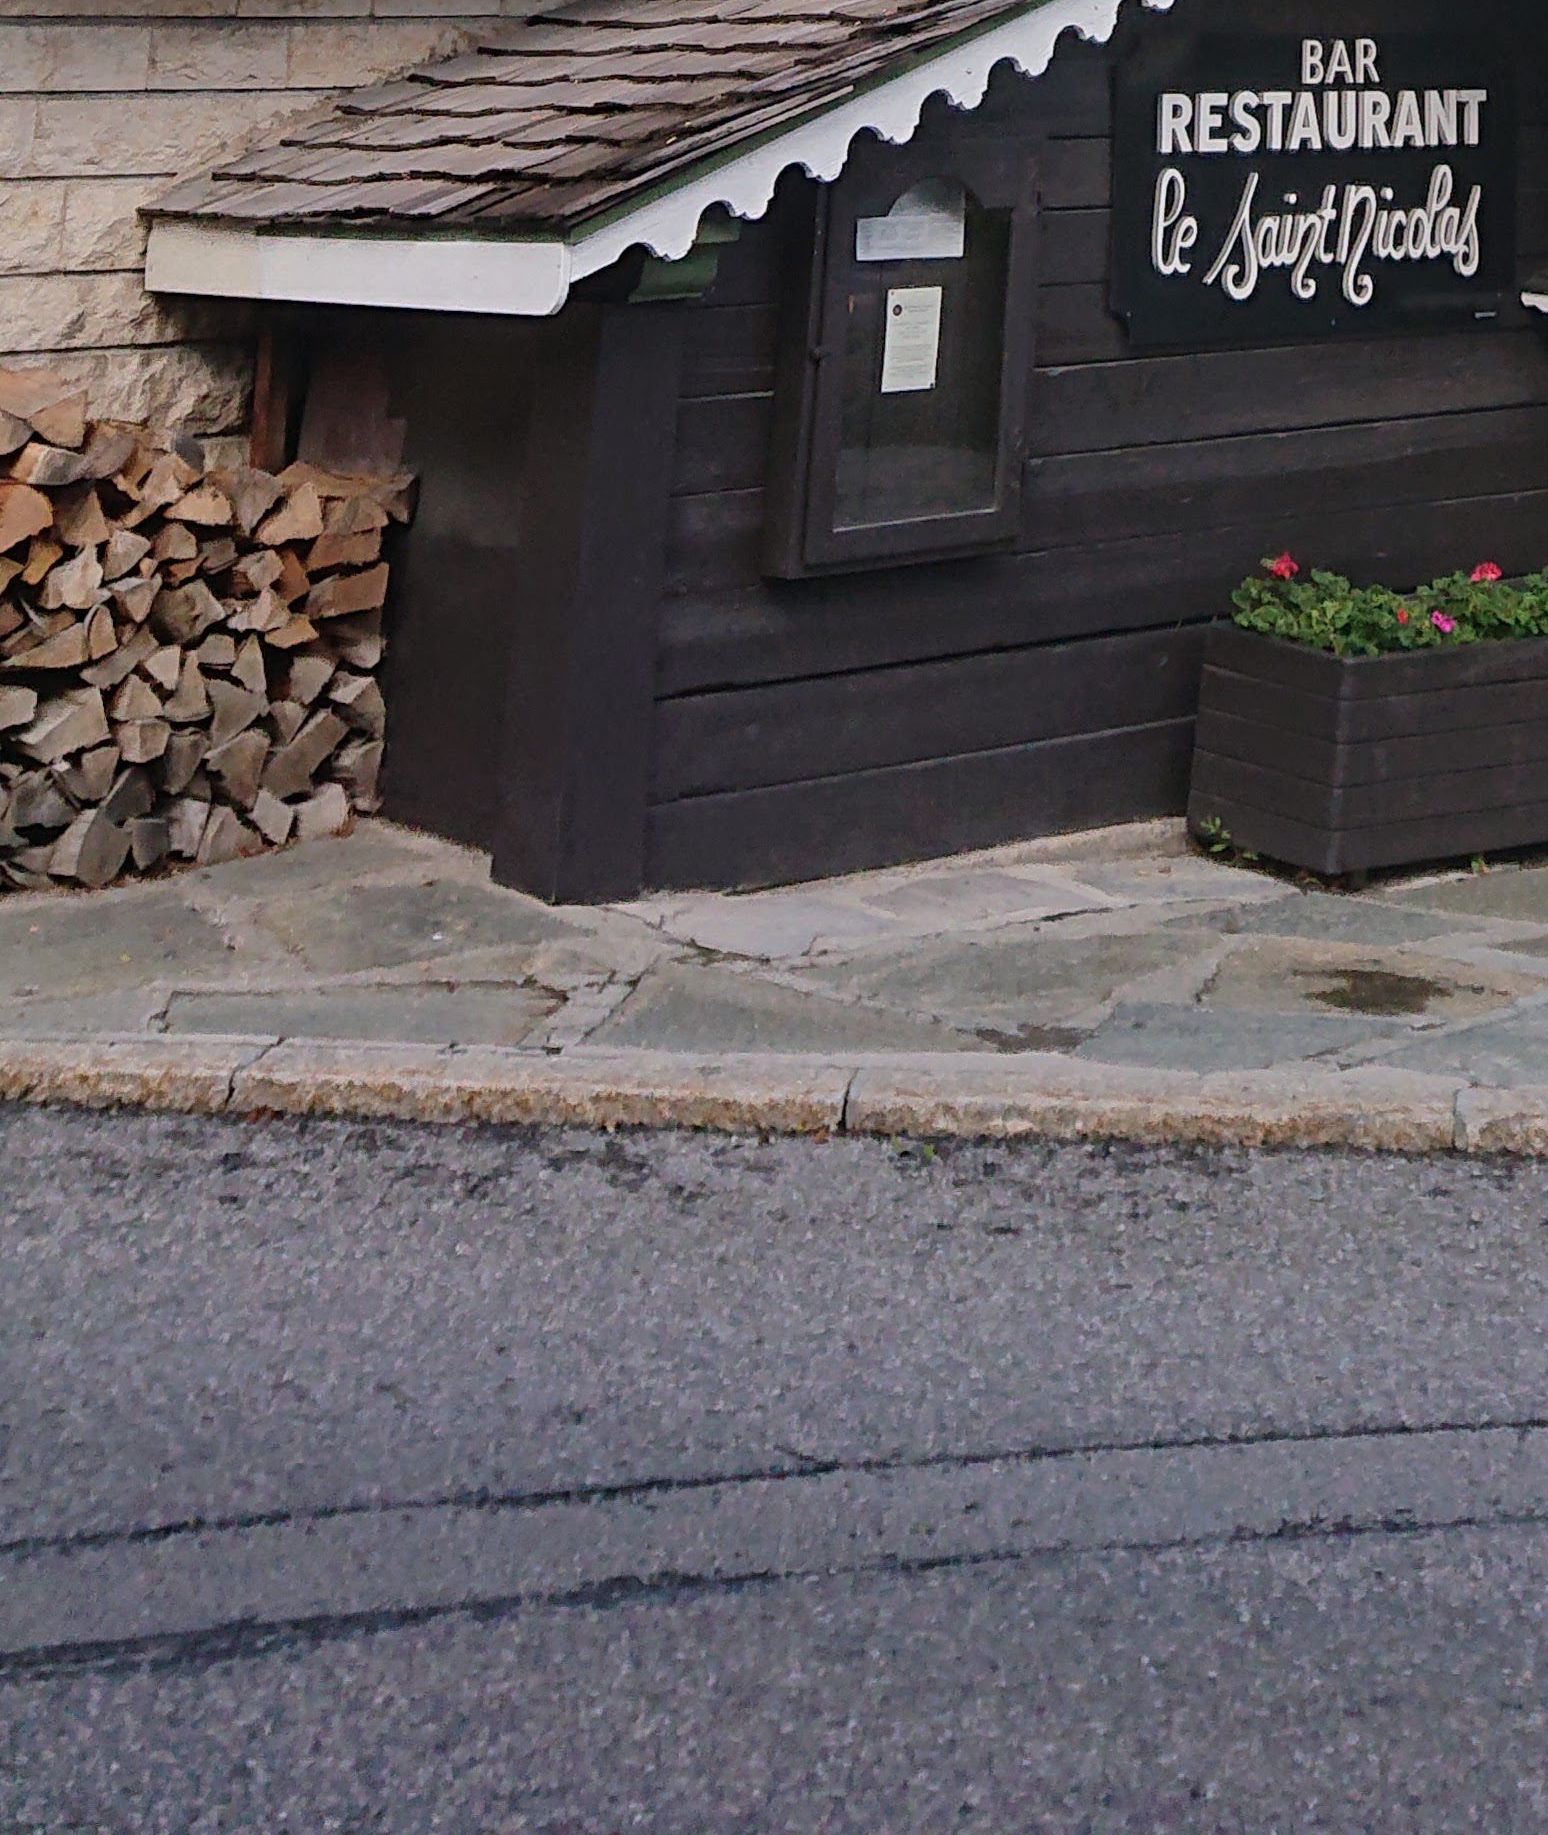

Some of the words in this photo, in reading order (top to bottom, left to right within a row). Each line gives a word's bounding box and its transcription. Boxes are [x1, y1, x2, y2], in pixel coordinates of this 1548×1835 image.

[1301, 37, 1381, 86] BAR
[1157, 88, 1488, 155] RESTAURANT
[1151, 167, 1199, 276] le
